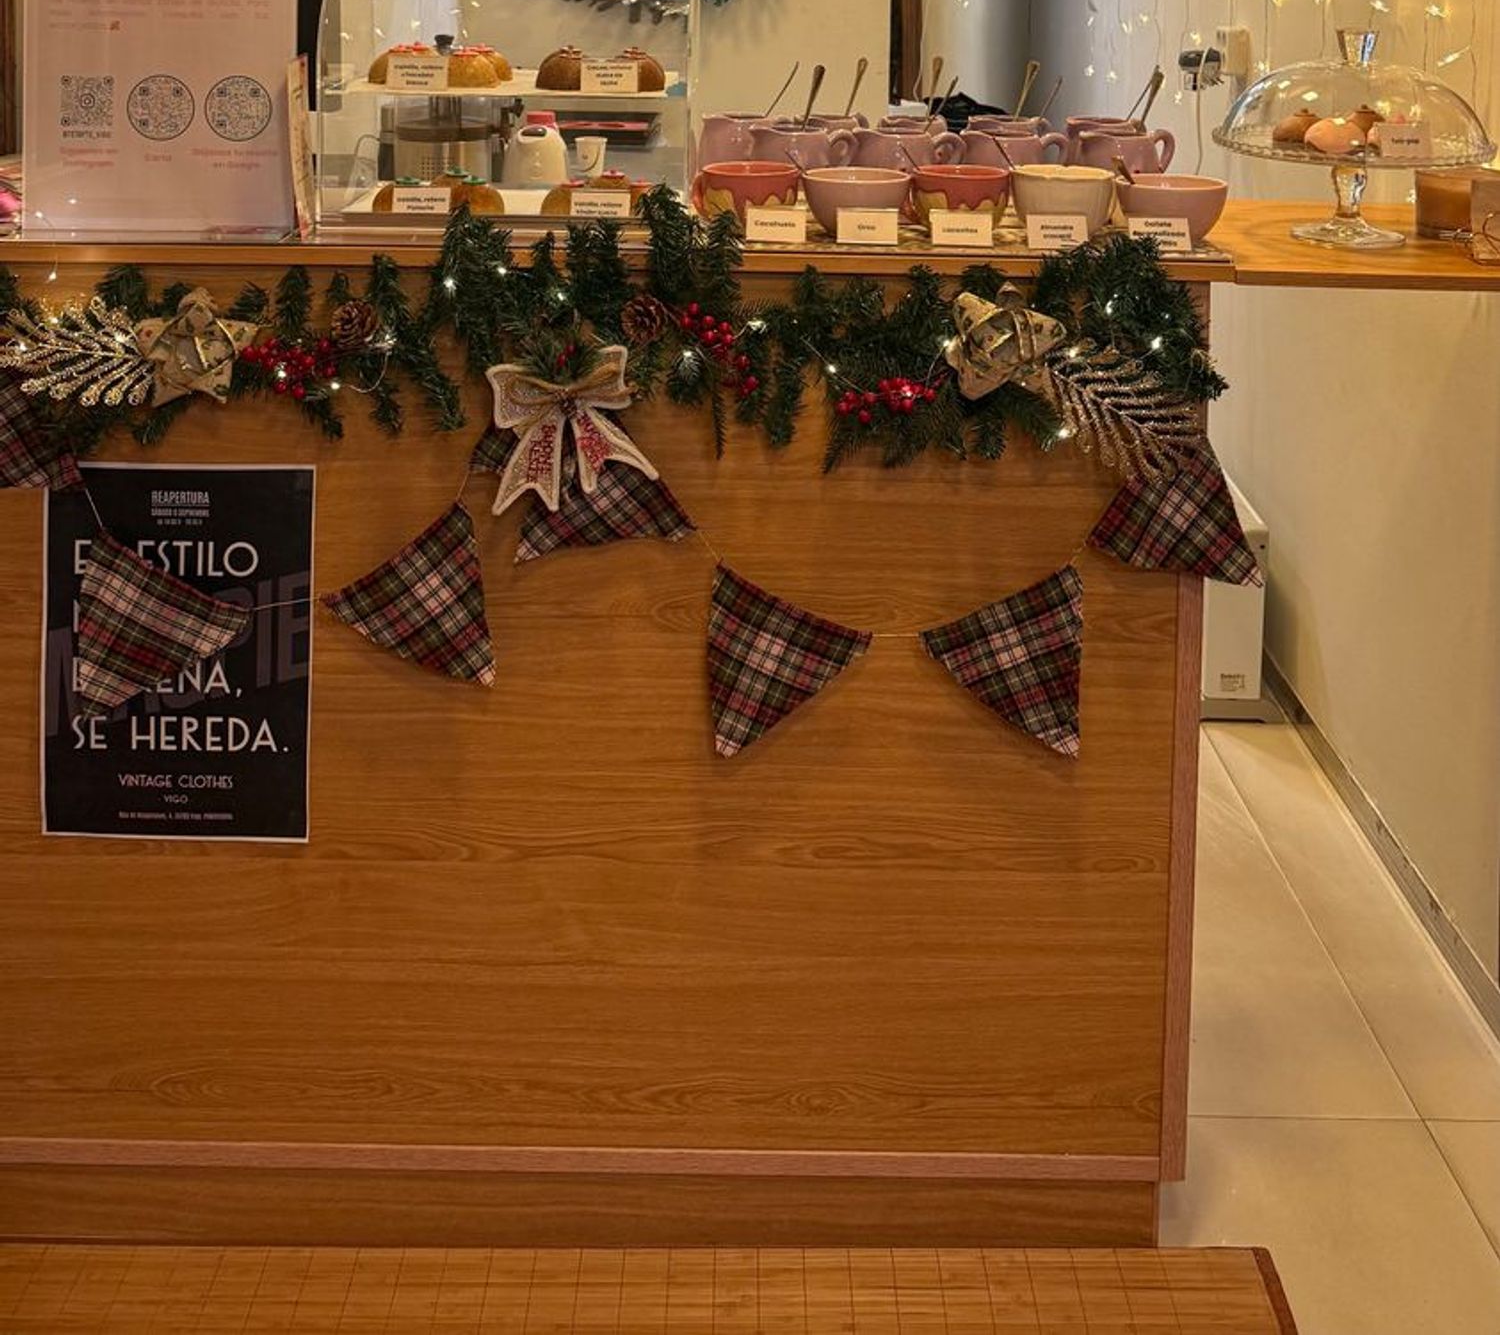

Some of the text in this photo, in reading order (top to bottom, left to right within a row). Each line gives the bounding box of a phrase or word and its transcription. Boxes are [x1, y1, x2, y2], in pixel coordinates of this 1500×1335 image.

[151, 490, 210, 504] REAPERTURA
[138, 540, 259, 577] ESTILO
[71, 715, 289, 753] SE HEREDA.
[118, 773, 234, 788] VINTAGE CLOTHES
